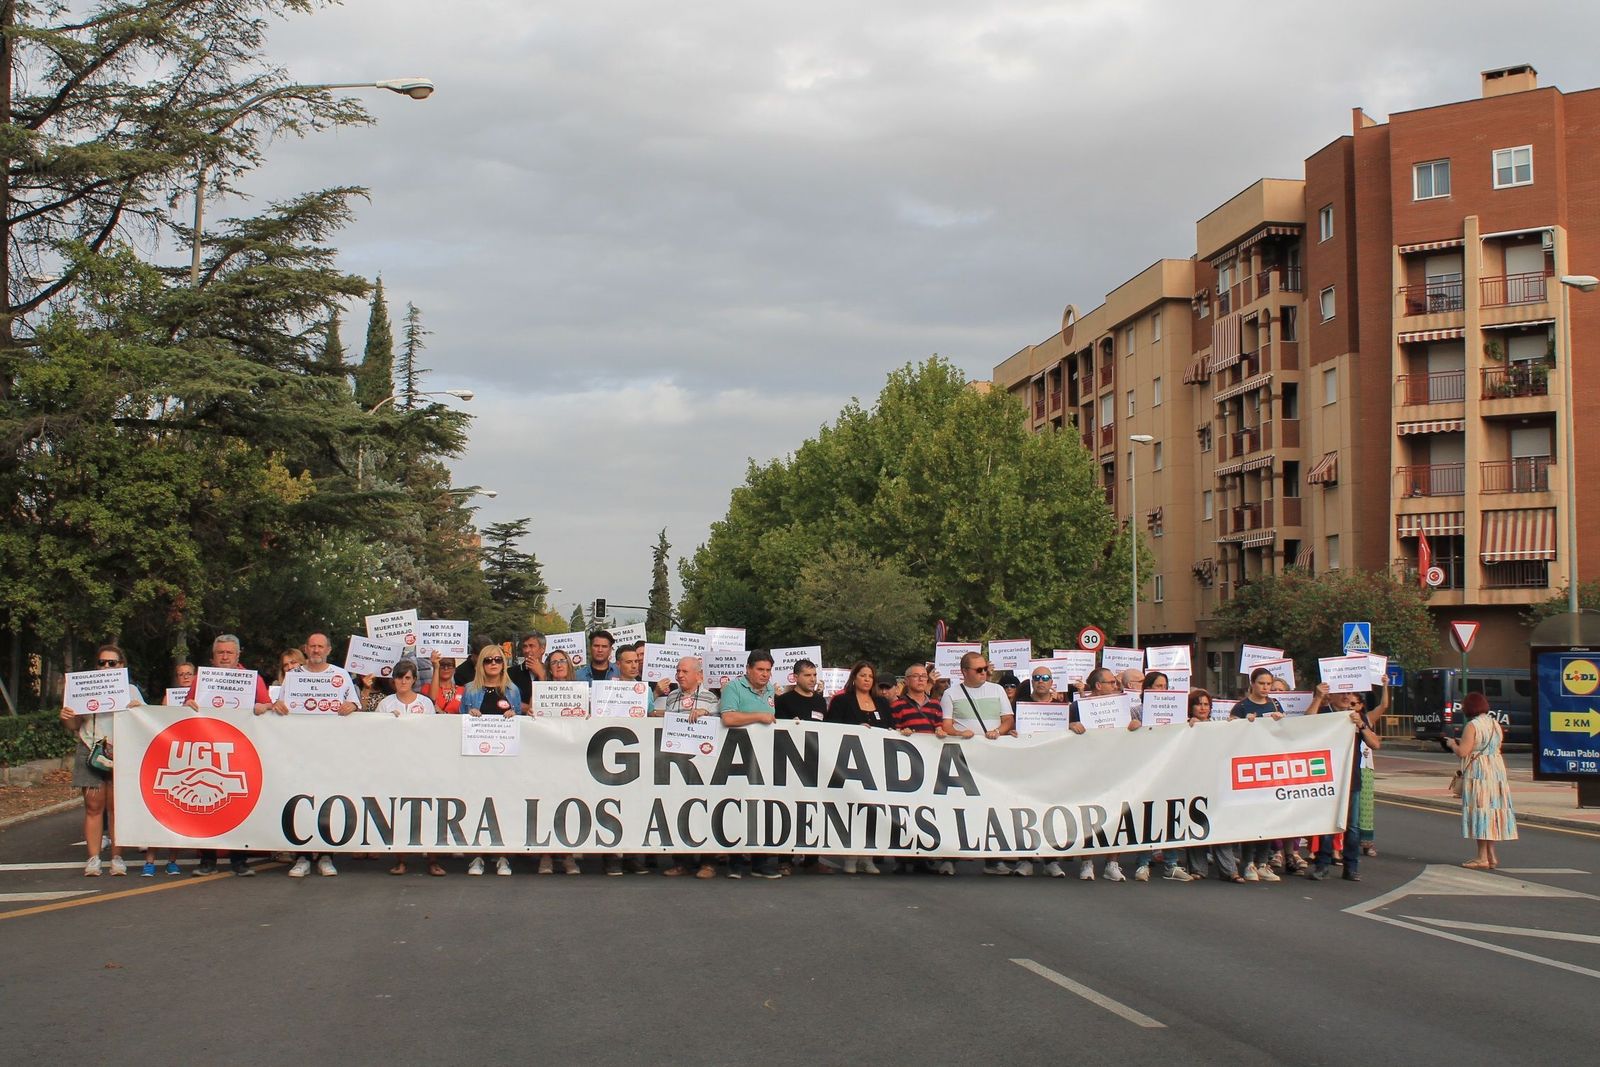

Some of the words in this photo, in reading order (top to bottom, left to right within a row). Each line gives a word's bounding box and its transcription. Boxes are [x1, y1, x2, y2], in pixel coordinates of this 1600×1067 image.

[1414, 712, 1440, 723] POLICÍA
[1452, 702, 1510, 725] PCÍA
[667, 732, 713, 740] INCUMPLIMIENTO
[168, 740, 234, 772] UGT
[586, 726, 981, 796] GRANADA
[1543, 748, 1556, 757] Av.
[1557, 749, 1576, 757] Juan
[1578, 749, 1600, 758] Pablo
[1275, 784, 1335, 800] Granada
[281, 794, 505, 847] CONTRA
[524, 798, 624, 848] LOS
[643, 798, 941, 850] ACCIDENTES
[954, 796, 1210, 852] LABORALES
